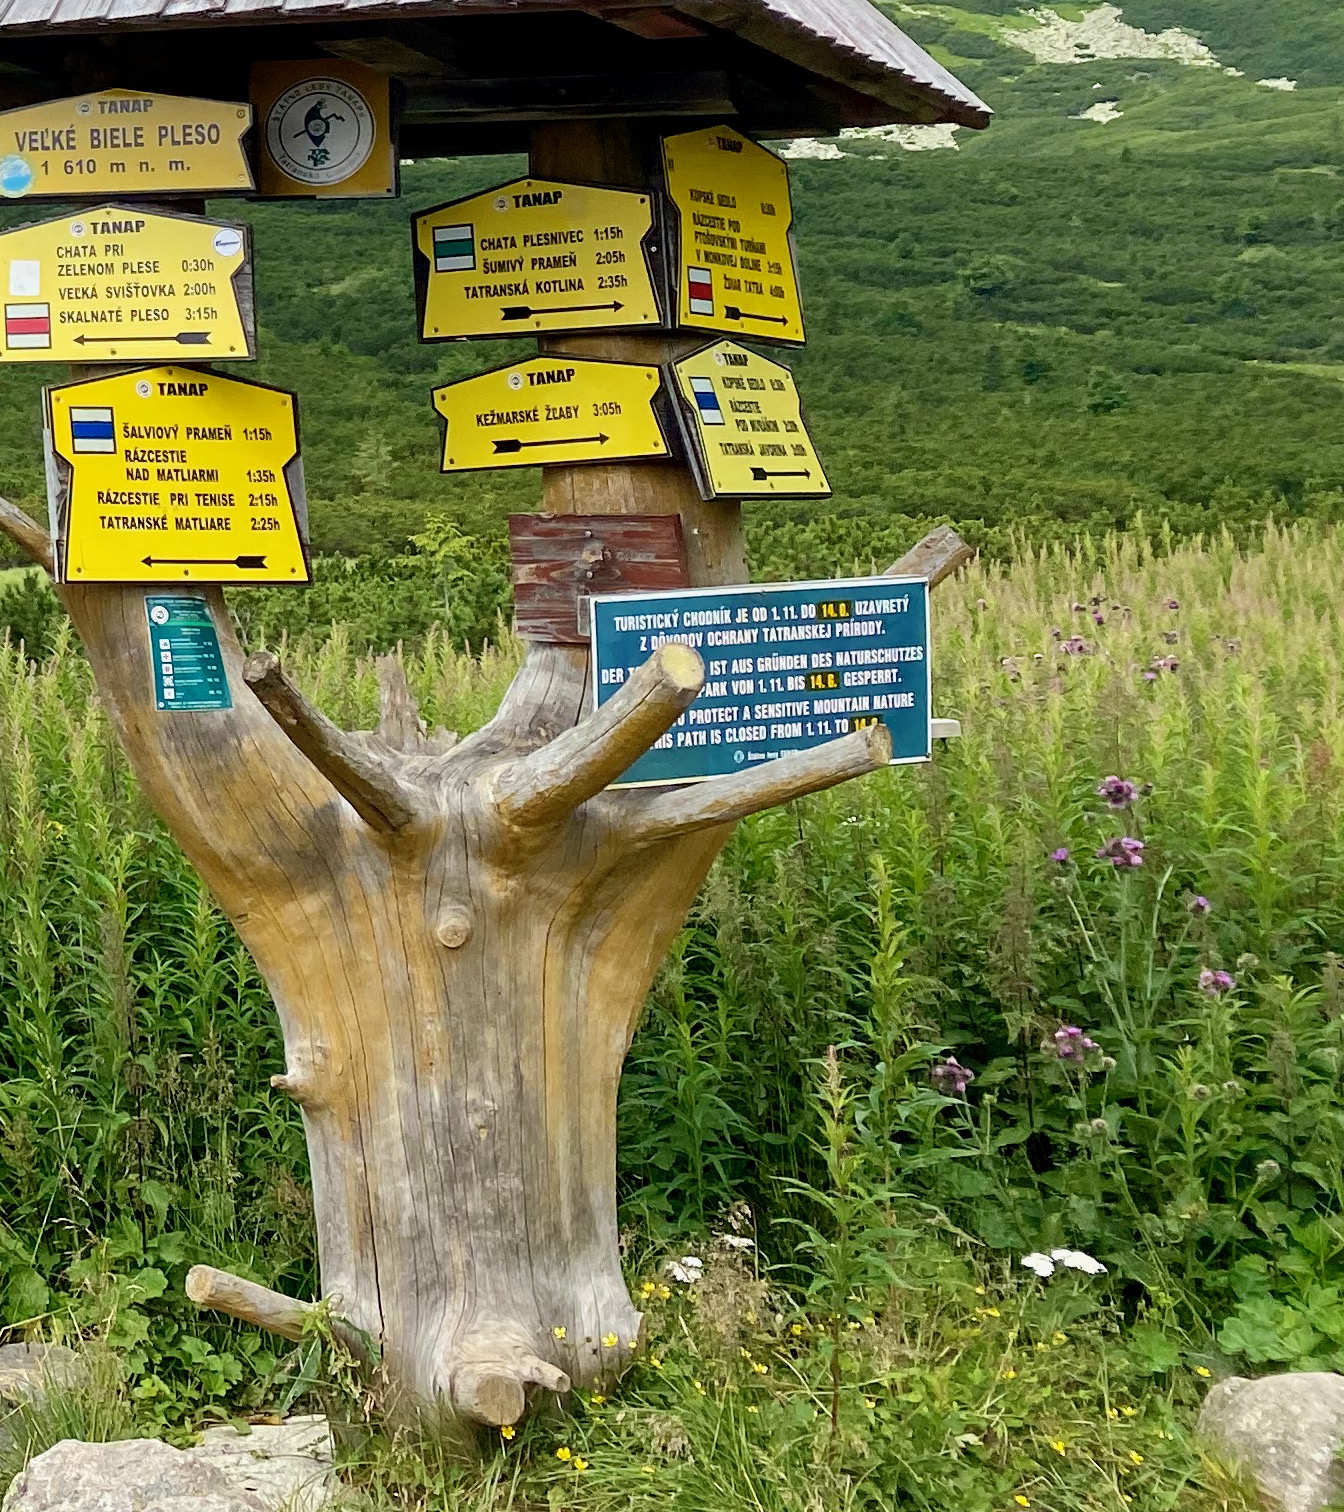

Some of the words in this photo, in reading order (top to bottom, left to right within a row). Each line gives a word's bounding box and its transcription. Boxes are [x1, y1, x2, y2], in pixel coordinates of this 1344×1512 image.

[99, 99, 153, 115] TANAP
[15, 124, 77, 152] VEĽKÉ
[90, 127, 145, 150] BIELE
[158, 124, 220, 147] PLESO
[41, 160, 49, 176] 1
[64, 159, 96, 175] 610
[110, 161, 126, 173] m
[139, 161, 155, 173] n.
[169, 159, 191, 172] m.
[513, 191, 562, 209] TANAP
[91, 221, 145, 235] TANAP
[481, 235, 517, 252] CHATA
[523, 230, 584, 247] PLESNIVEC
[594, 226, 623, 241] 1:15h
[57, 245, 97, 259] CHATA
[105, 244, 124, 257] PRI
[58, 263, 115, 277] ZELENOM
[122, 261, 160, 275] PLESE
[182, 259, 215, 273] 0:30h
[483, 256, 525, 275] ŠUMIVÝ
[532, 252, 577, 271] PRAMEŇ
[596, 251, 626, 265] 2:05h
[59, 284, 98, 300] VEĽKÁ
[106, 282, 176, 299] SVIŠŤOVKA
[184, 283, 216, 297] 2:00h
[464, 279, 529, 300] TATRANSKÁ
[536, 278, 584, 294] KOTLINA
[598, 275, 628, 289] 2:35h
[59, 306, 123, 324] SKALNATÉ
[131, 309, 169, 322] PLESO
[185, 307, 218, 321] 3:15h
[722, 353, 749, 367] TANAP
[527, 369, 576, 387] TANAP
[157, 383, 209, 397] TANAP
[476, 406, 539, 428] KEŽMARSKÉ
[593, 401, 622, 417] 3:05h
[123, 422, 179, 440] ŠALVIOVÝ
[186, 424, 232, 441] PRAMEŇ
[243, 427, 272, 441] 1:15h
[125, 447, 187, 463] RÁZCESTIE
[126, 468, 149, 482] NAD
[157, 469, 219, 483] MATLIARMI
[247, 469, 276, 483] 1:35h
[97, 488, 160, 506] RÁZCESTIE
[170, 493, 188, 507] PRI
[195, 493, 235, 507] TENISE
[248, 493, 278, 507] 2:15h
[100, 514, 168, 531] TATRANSKÉ
[175, 517, 231, 531] MATLIARE
[251, 517, 281, 531] 2:25h
[614, 609, 679, 632] TURISTICKÝ
[683, 606, 732, 628] CHODNÍK
[736, 608, 749, 624] JE
[753, 607, 768, 623] OD
[771, 607, 781, 621] 1.
[783, 605, 798, 620] 11.
[801, 604, 816, 619] DO
[822, 603, 838, 618] 14.
[855, 594, 910, 616] UZAVRETÝ
[640, 637, 647, 652] Z
[708, 628, 759, 647] OCHRANY
[763, 624, 832, 642] TATRANSKEJ
[836, 618, 886, 637] PRÍRODY.
[602, 668, 624, 685] DER
[710, 660, 728, 676] IST
[732, 658, 754, 675] AUS
[757, 653, 808, 673] GRÜNDEN
[812, 653, 833, 668] DES
[836, 646, 924, 667] NATURSCHUTZES
[732, 680, 754, 696] VON
[758, 679, 767, 693] 1.
[770, 678, 784, 692] 11.
[787, 676, 806, 691] BIS
[810, 674, 826, 689] 14.
[844, 669, 902, 687] GESPERRT.
[690, 707, 739, 725] PROTECT
[743, 706, 751, 721] A
[754, 703, 810, 720] SENSITIVE
[814, 696, 870, 715] MOUNTAIN
[873, 693, 915, 710] NATURE
[650, 734, 673, 750] HIS
[677, 730, 707, 747] PATH
[711, 729, 722, 745] IS
[726, 726, 767, 743] CLOSED
[771, 722, 802, 739] FROM
[806, 723, 815, 737] 1.
[817, 721, 831, 735] 11.
[835, 718, 849, 734] TO
